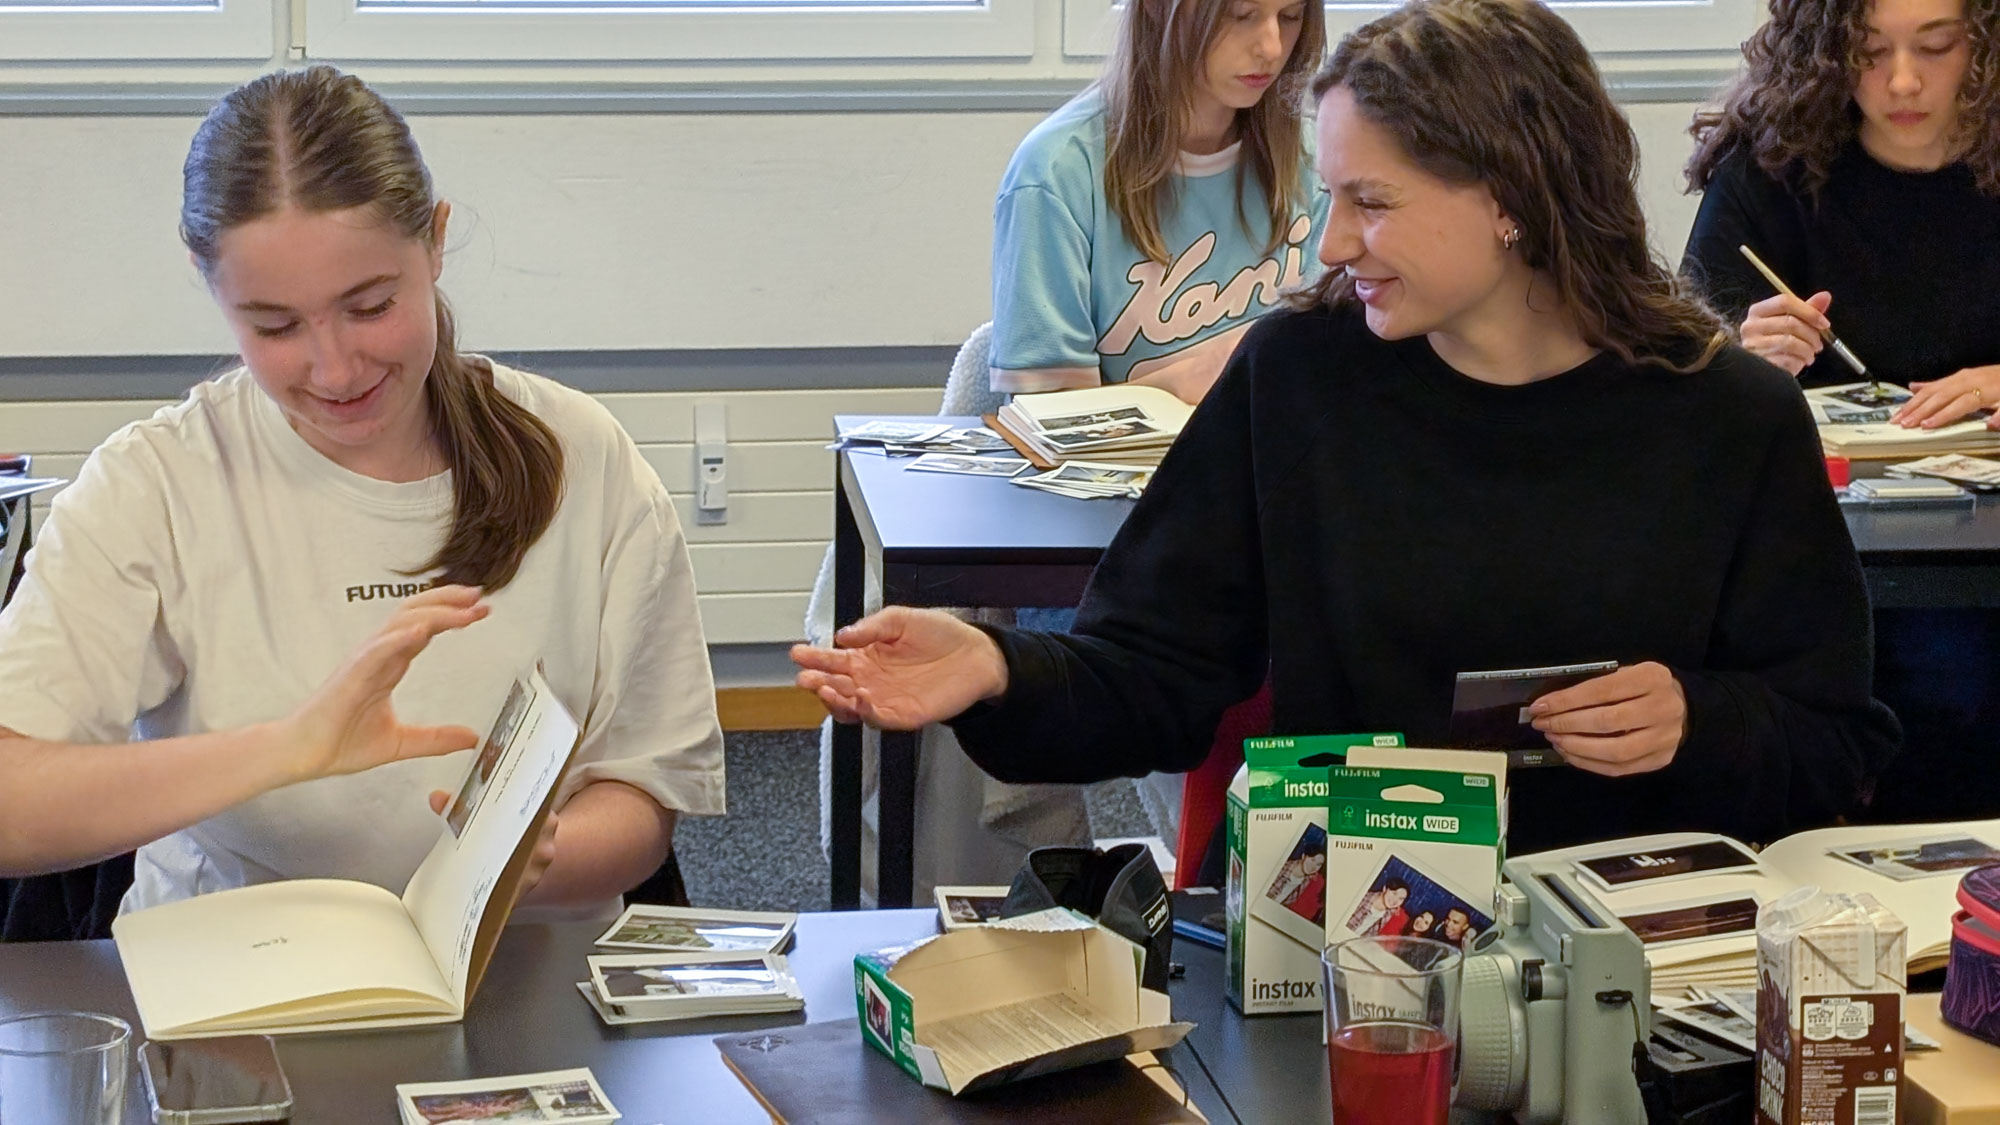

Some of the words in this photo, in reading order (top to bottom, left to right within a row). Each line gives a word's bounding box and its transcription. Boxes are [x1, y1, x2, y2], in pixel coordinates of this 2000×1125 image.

[1250, 739, 1295, 749] FUJIFILM
[1375, 737, 1397, 745] WIDE
[1334, 769, 1381, 778] FUJIFILM
[1255, 812, 1293, 821] FUJIFILM
[1365, 809, 1418, 830] instax
[1425, 819, 1457, 831] WIDE
[1335, 840, 1374, 851] FUJIFILM
[1252, 978, 1316, 1000] instax
